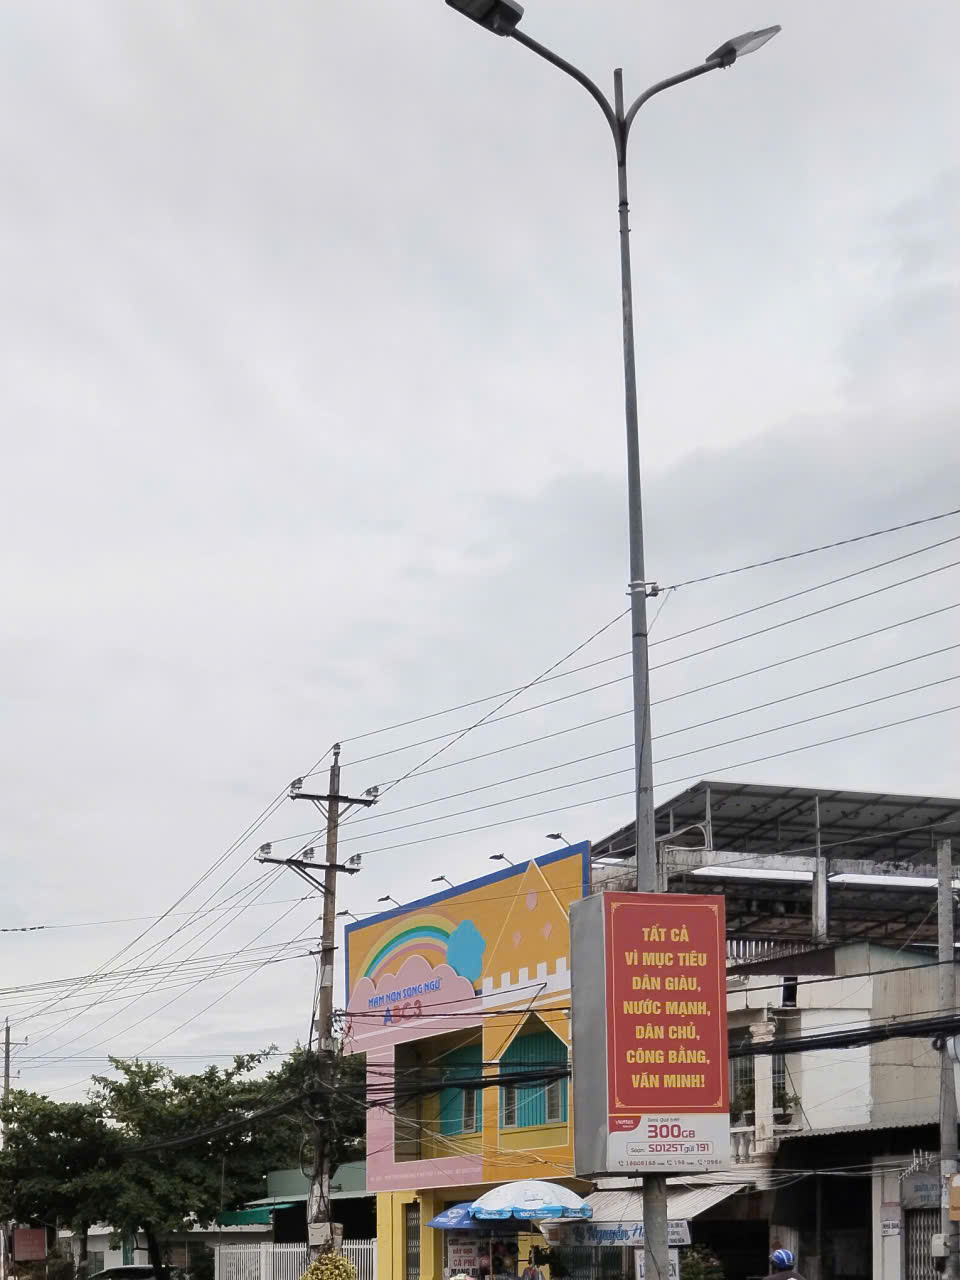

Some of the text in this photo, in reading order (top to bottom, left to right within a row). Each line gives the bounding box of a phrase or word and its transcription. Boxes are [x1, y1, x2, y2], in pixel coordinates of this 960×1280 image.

[642, 923, 689, 942] TẤT CẢ
[625, 949, 707, 968] VÌ MỤC TIÊU
[632, 974, 701, 993] DÂN GIÀU,
[623, 998, 711, 1018] NƯỚC MẠNH,
[635, 1021, 700, 1041] DÂN CHỦ,
[626, 1044, 710, 1065] CÔNG BẰNG,
[631, 1071, 705, 1088] VĂN MINH!
[696, 1143, 710, 1152] 191
